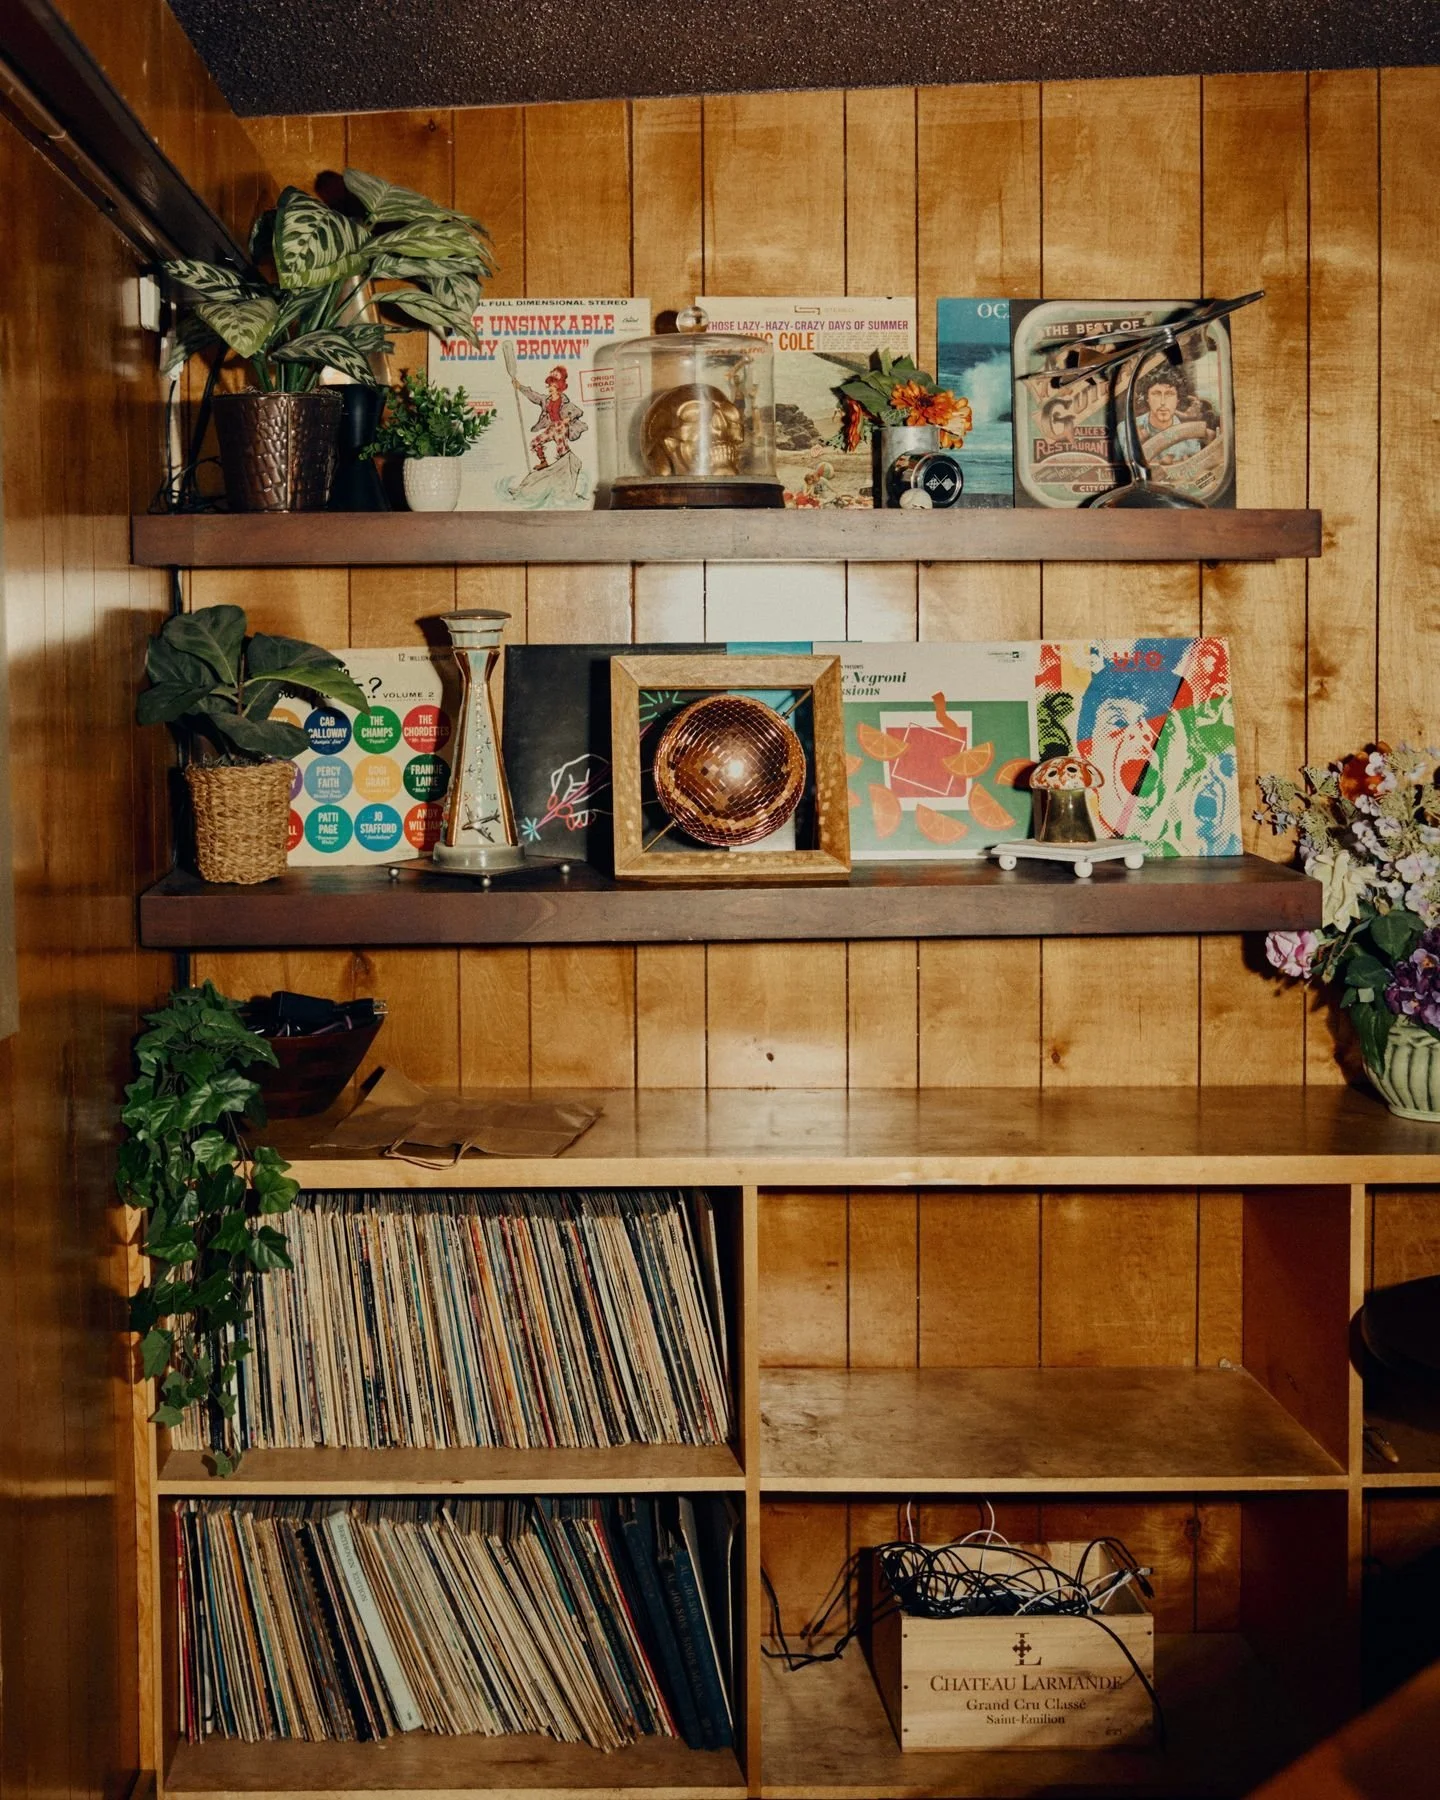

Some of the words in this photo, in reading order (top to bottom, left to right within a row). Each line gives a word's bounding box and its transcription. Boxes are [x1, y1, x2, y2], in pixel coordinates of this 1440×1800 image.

[489, 313, 615, 336] UNSINKABLE
[828, 320, 852, 330] DAYS
[854, 320, 865, 330] OF
[868, 320, 909, 330] SUMMER
[1044, 325, 1068, 337] THE
[1120, 320, 1140, 331] OF
[779, 332, 815, 351] COLE
[440, 339, 498, 361] MOLLY
[1074, 427, 1106, 436] ALICE'S
[1036, 439, 1108, 458] RESTAURANT
[398, 653, 405, 662] 12
[854, 671, 907, 686] Negroni
[319, 716, 335, 727] CAB
[369, 715, 384, 726] THE
[418, 714, 433, 725] THE
[361, 727, 394, 738] CHAMPS
[404, 726, 450, 737] CHORDETTES
[316, 766, 341, 777] PERCY
[410, 764, 443, 775] FRANKIE
[317, 778, 340, 788] FAITH
[416, 777, 438, 787] LAINE
[318, 811, 339, 823] PATTI
[374, 811, 383, 821] JO
[416, 808, 438, 819] ANDY
[318, 823, 339, 834] PAGE
[360, 823, 397, 834] STAFFORD
[337, 1524, 355, 1568] BEETHOVEN
[352, 1570, 369, 1602] EDITION
[930, 1675, 1015, 1692] CHATEAU
[1023, 1674, 1123, 1691] LARMANDE
[966, 1699, 1009, 1711] Grand
[1014, 1699, 1040, 1711] Cru
[1044, 1699, 1087, 1711] Classé
